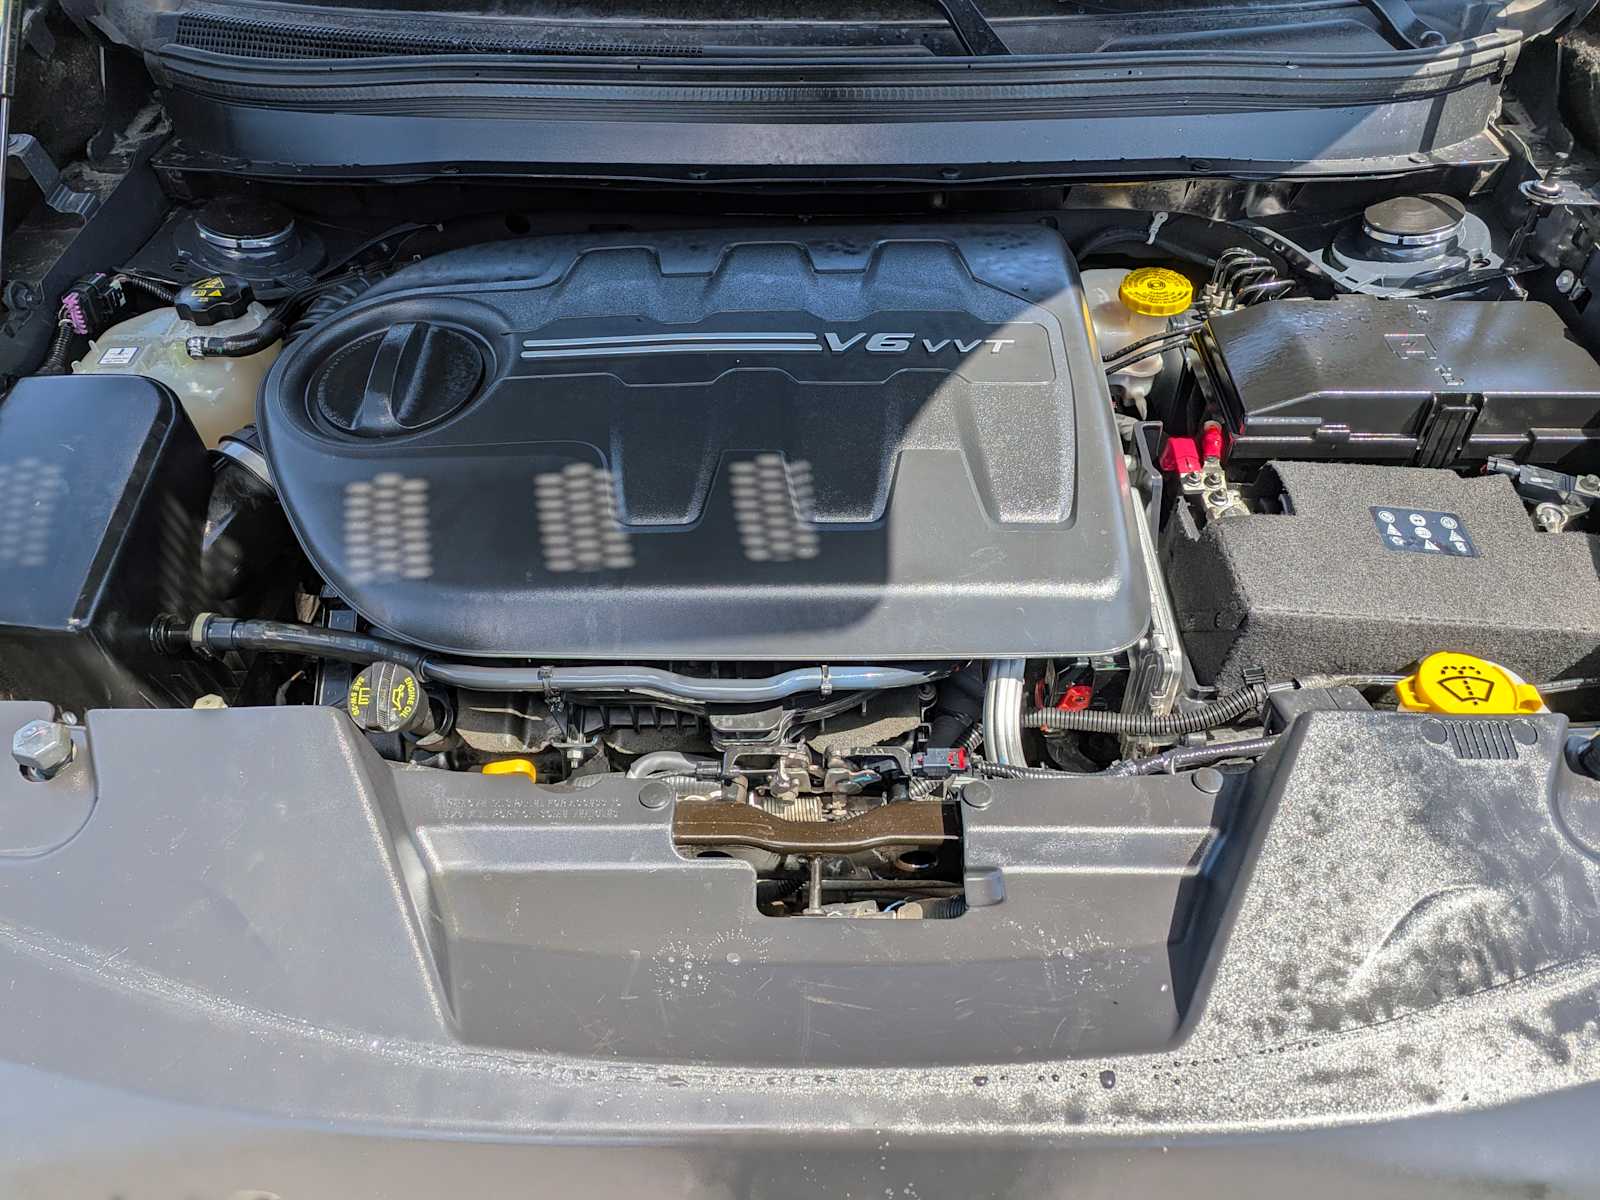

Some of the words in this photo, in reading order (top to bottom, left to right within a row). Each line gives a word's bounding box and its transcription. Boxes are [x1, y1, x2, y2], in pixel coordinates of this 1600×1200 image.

[824, 333, 915, 352] V6
[922, 339, 1015, 353] VVT
[352, 676, 365, 691] SAE
[404, 677, 416, 705] ENGINE
[399, 706, 412, 718] OIL
